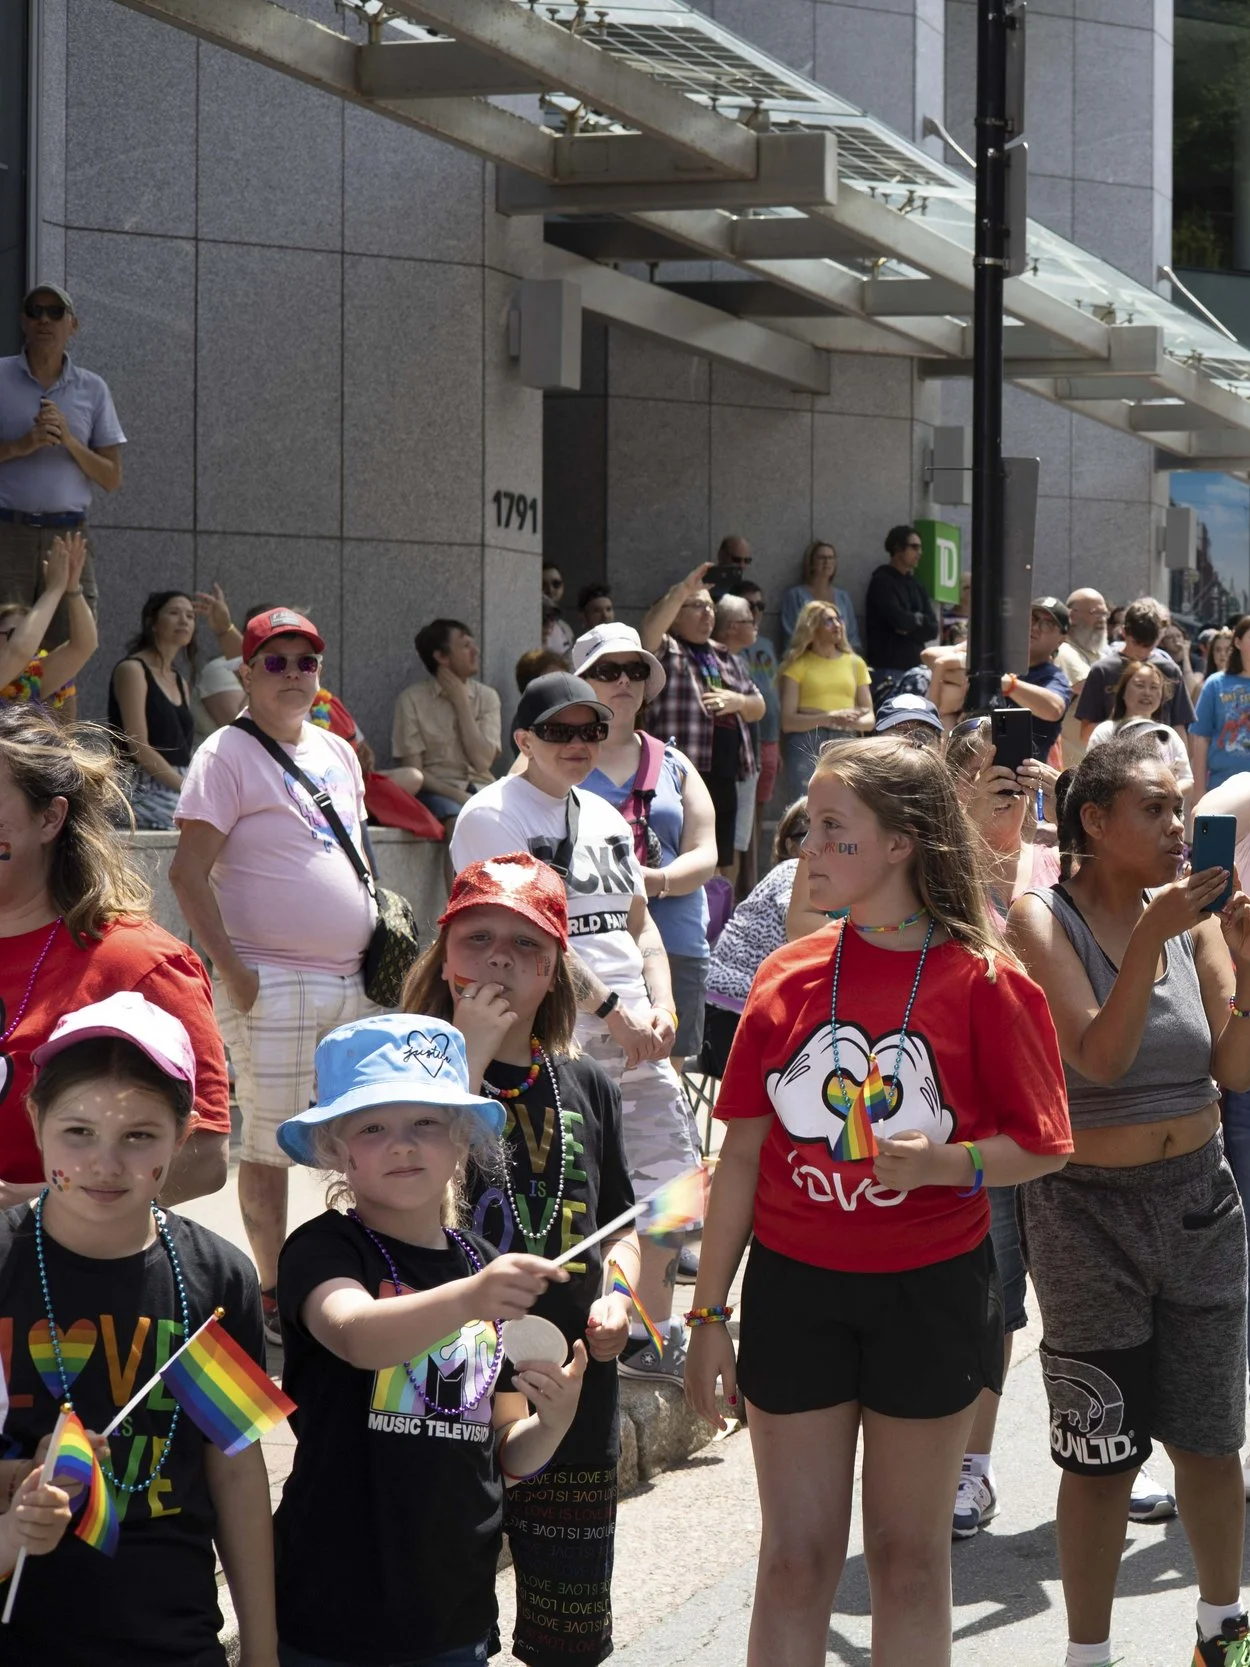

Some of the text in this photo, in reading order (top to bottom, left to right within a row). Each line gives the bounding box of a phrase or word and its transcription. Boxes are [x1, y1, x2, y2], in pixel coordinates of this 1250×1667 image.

[493, 490, 538, 534] 1791
[936, 536, 958, 588] TD
[529, 1180, 547, 1197] IS
[367, 1413, 421, 1436] MUSIC
[569, 1471, 602, 1484] LOVE
[562, 1601, 592, 1615] LOVE
